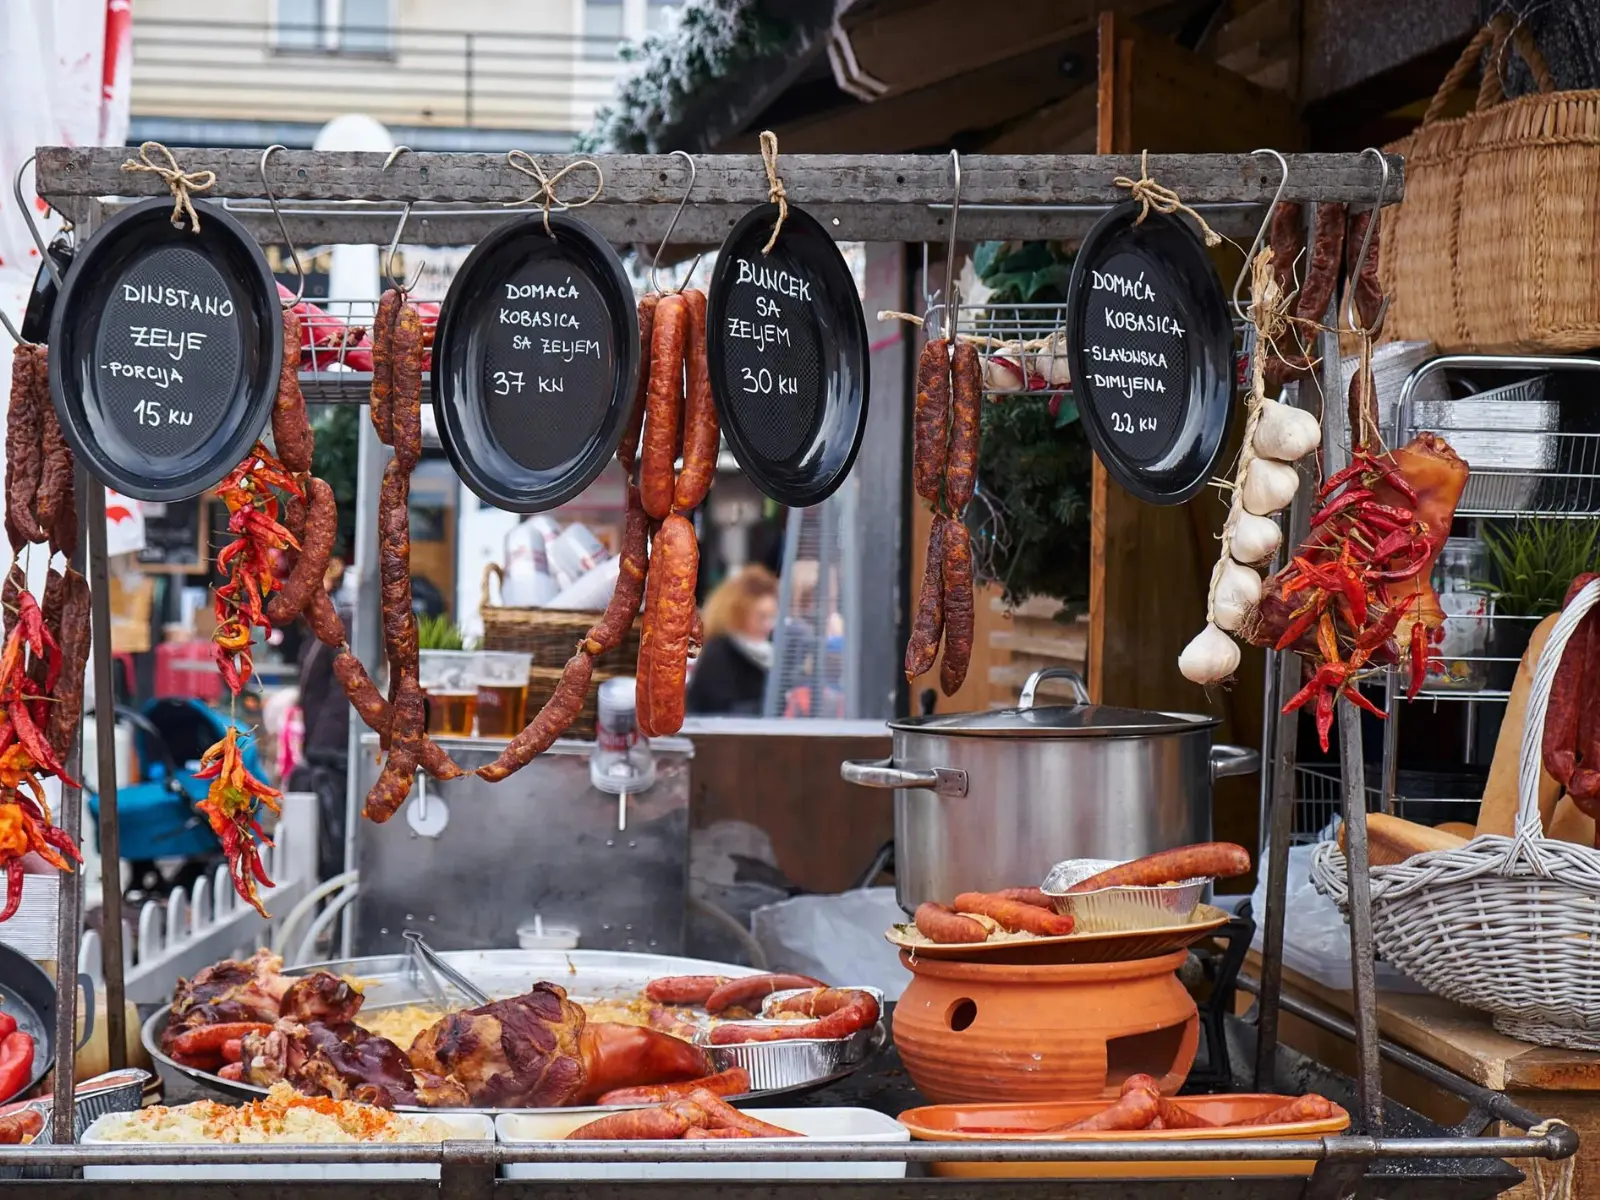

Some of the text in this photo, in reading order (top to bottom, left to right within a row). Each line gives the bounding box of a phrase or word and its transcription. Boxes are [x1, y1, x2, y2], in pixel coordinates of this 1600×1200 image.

[505, 276, 580, 300] DOMAĆA
[736, 259, 812, 301] BUNCEK
[1091, 270, 1156, 302] DOMAĆA
[123, 284, 233, 317] DINSTANO
[756, 296, 781, 318] SA
[499, 307, 580, 330] KOBASICA
[1105, 307, 1186, 338] KOBASICA
[512, 335, 532, 350] SA
[101, 361, 183, 388] -PORCIJA
[493, 370, 564, 396] 37 KN
[741, 367, 798, 394] 30 KN
[1085, 373, 1167, 398] -DIMLJENA
[133, 399, 193, 427] 15 KN
[1111, 411, 1157, 434] 22 KN
